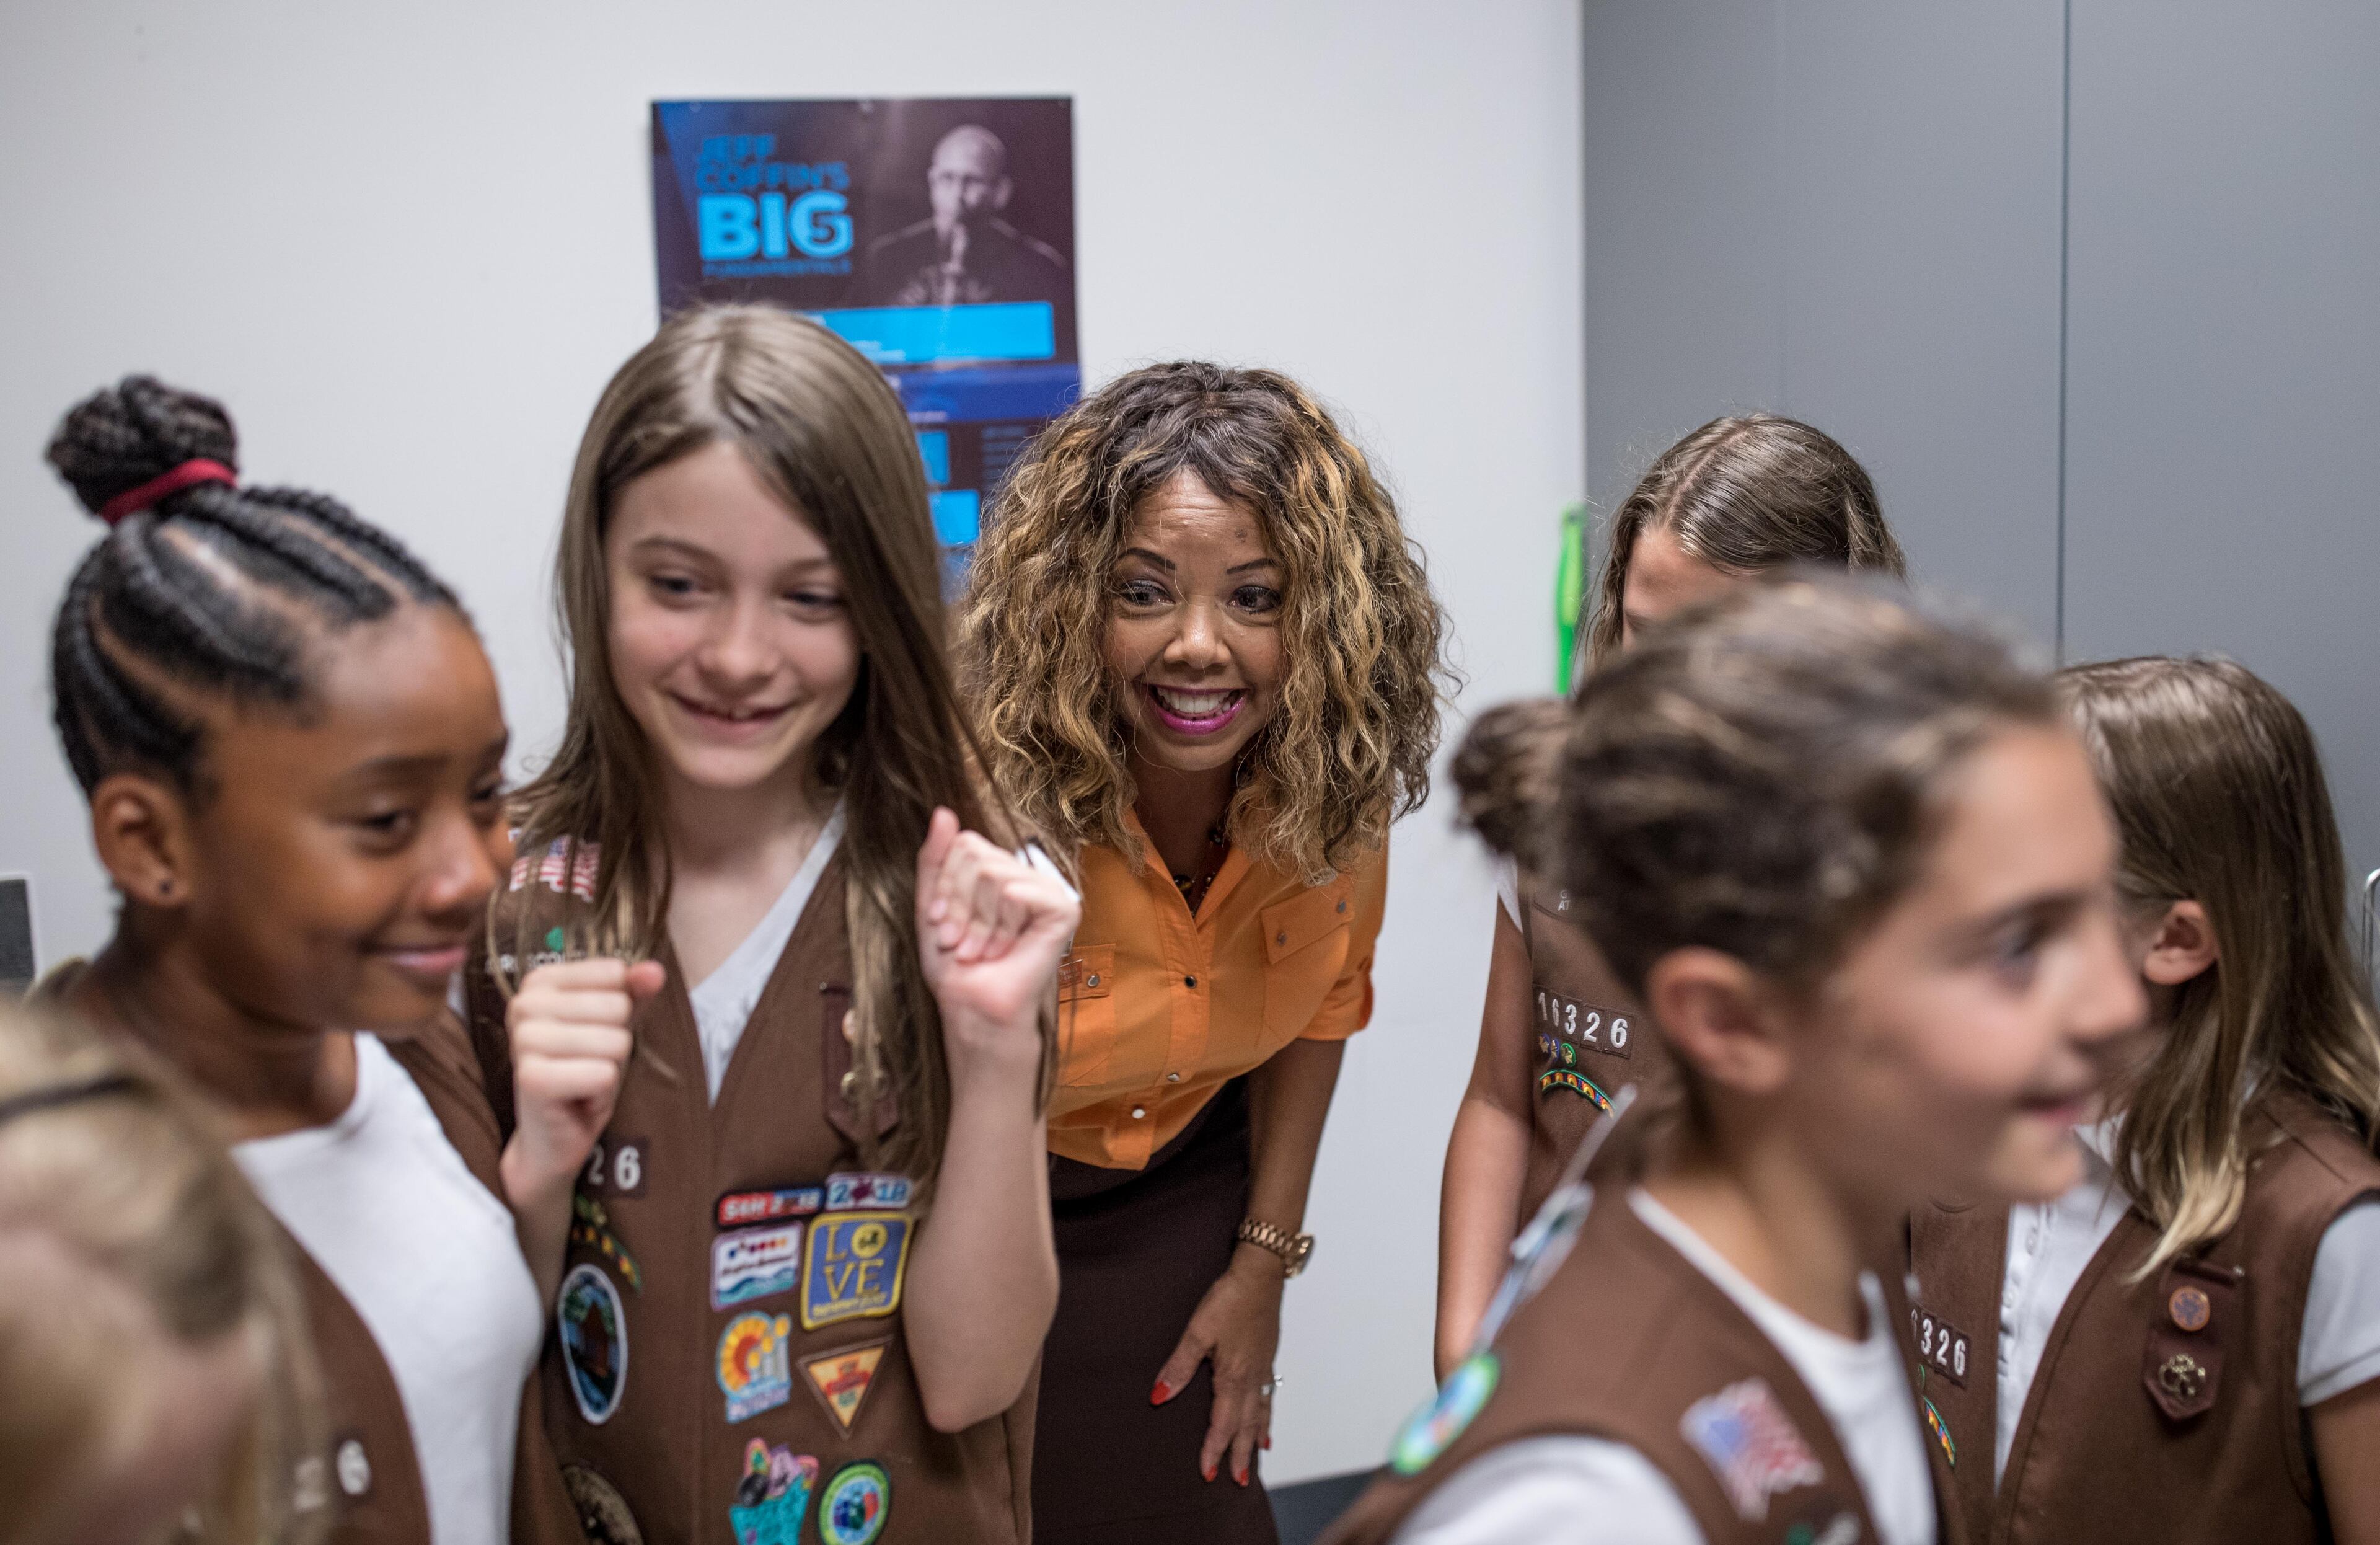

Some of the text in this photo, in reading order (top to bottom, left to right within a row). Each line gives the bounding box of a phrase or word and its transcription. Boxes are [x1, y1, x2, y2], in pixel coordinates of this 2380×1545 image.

[699, 135, 774, 163] JEFF
[699, 191, 853, 260] BIG
[1538, 992, 1629, 1050] 16326
